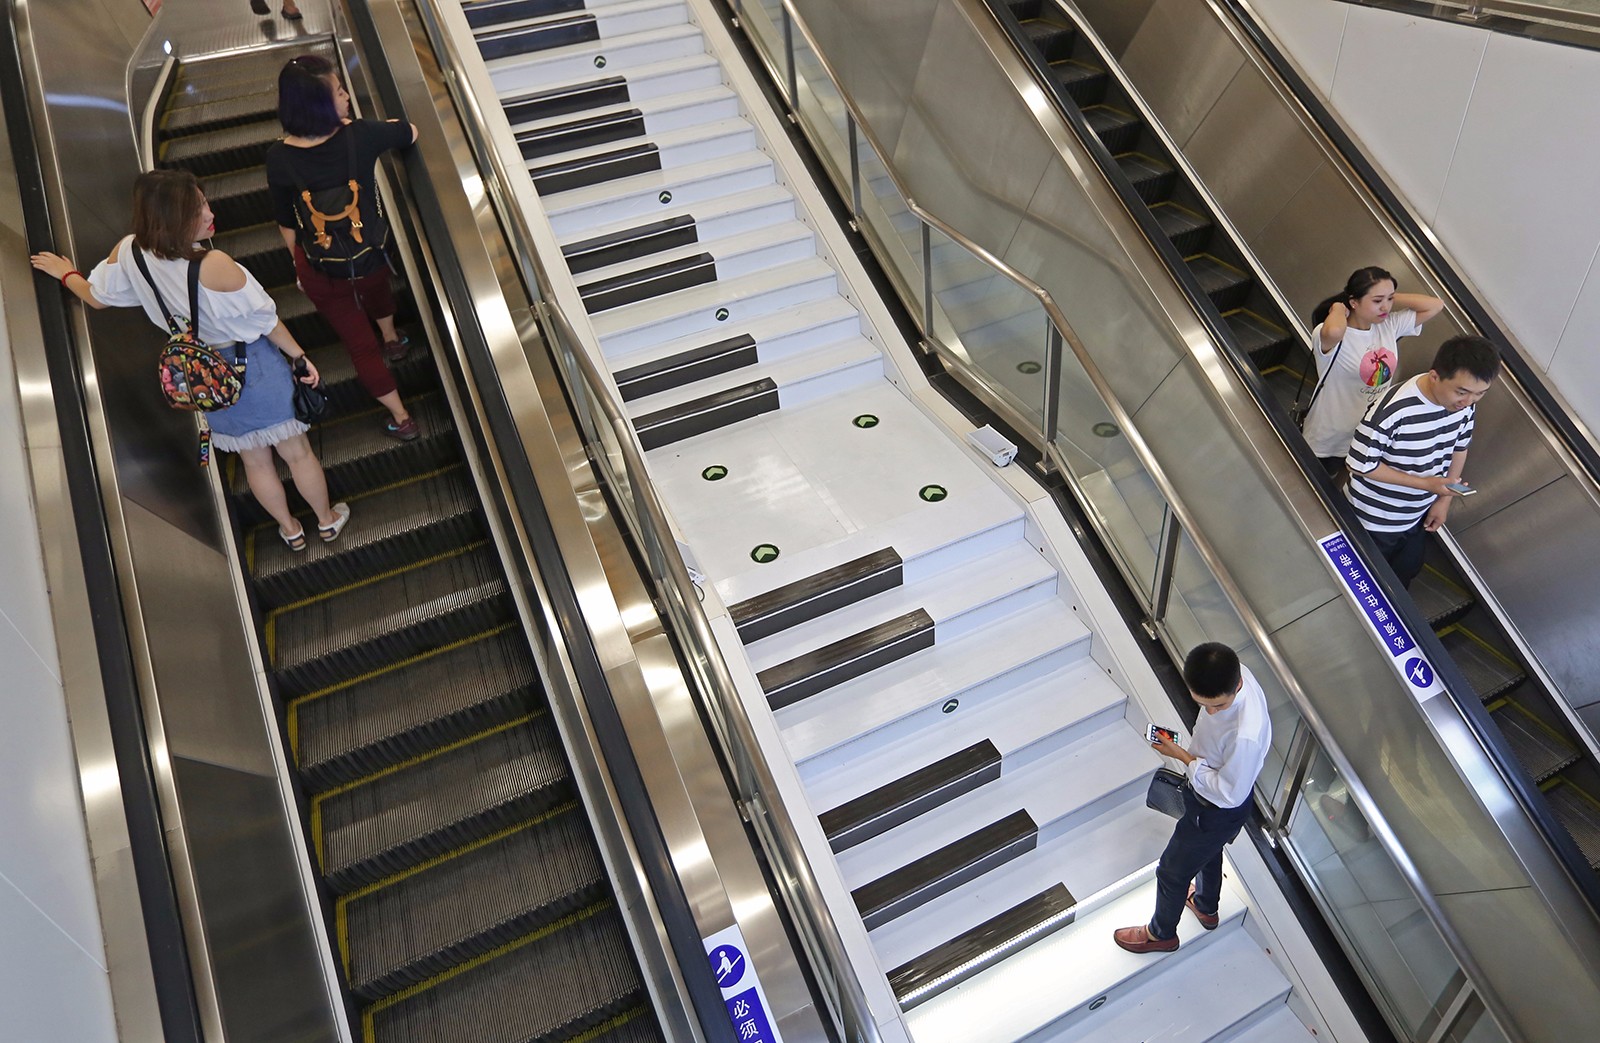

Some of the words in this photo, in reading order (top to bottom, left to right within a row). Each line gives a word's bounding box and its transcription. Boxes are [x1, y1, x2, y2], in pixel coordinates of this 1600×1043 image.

[201, 442, 209, 467] LOVE
[1339, 553, 1405, 649] 必须握住扶手带
[734, 999, 763, 1043] 必须
